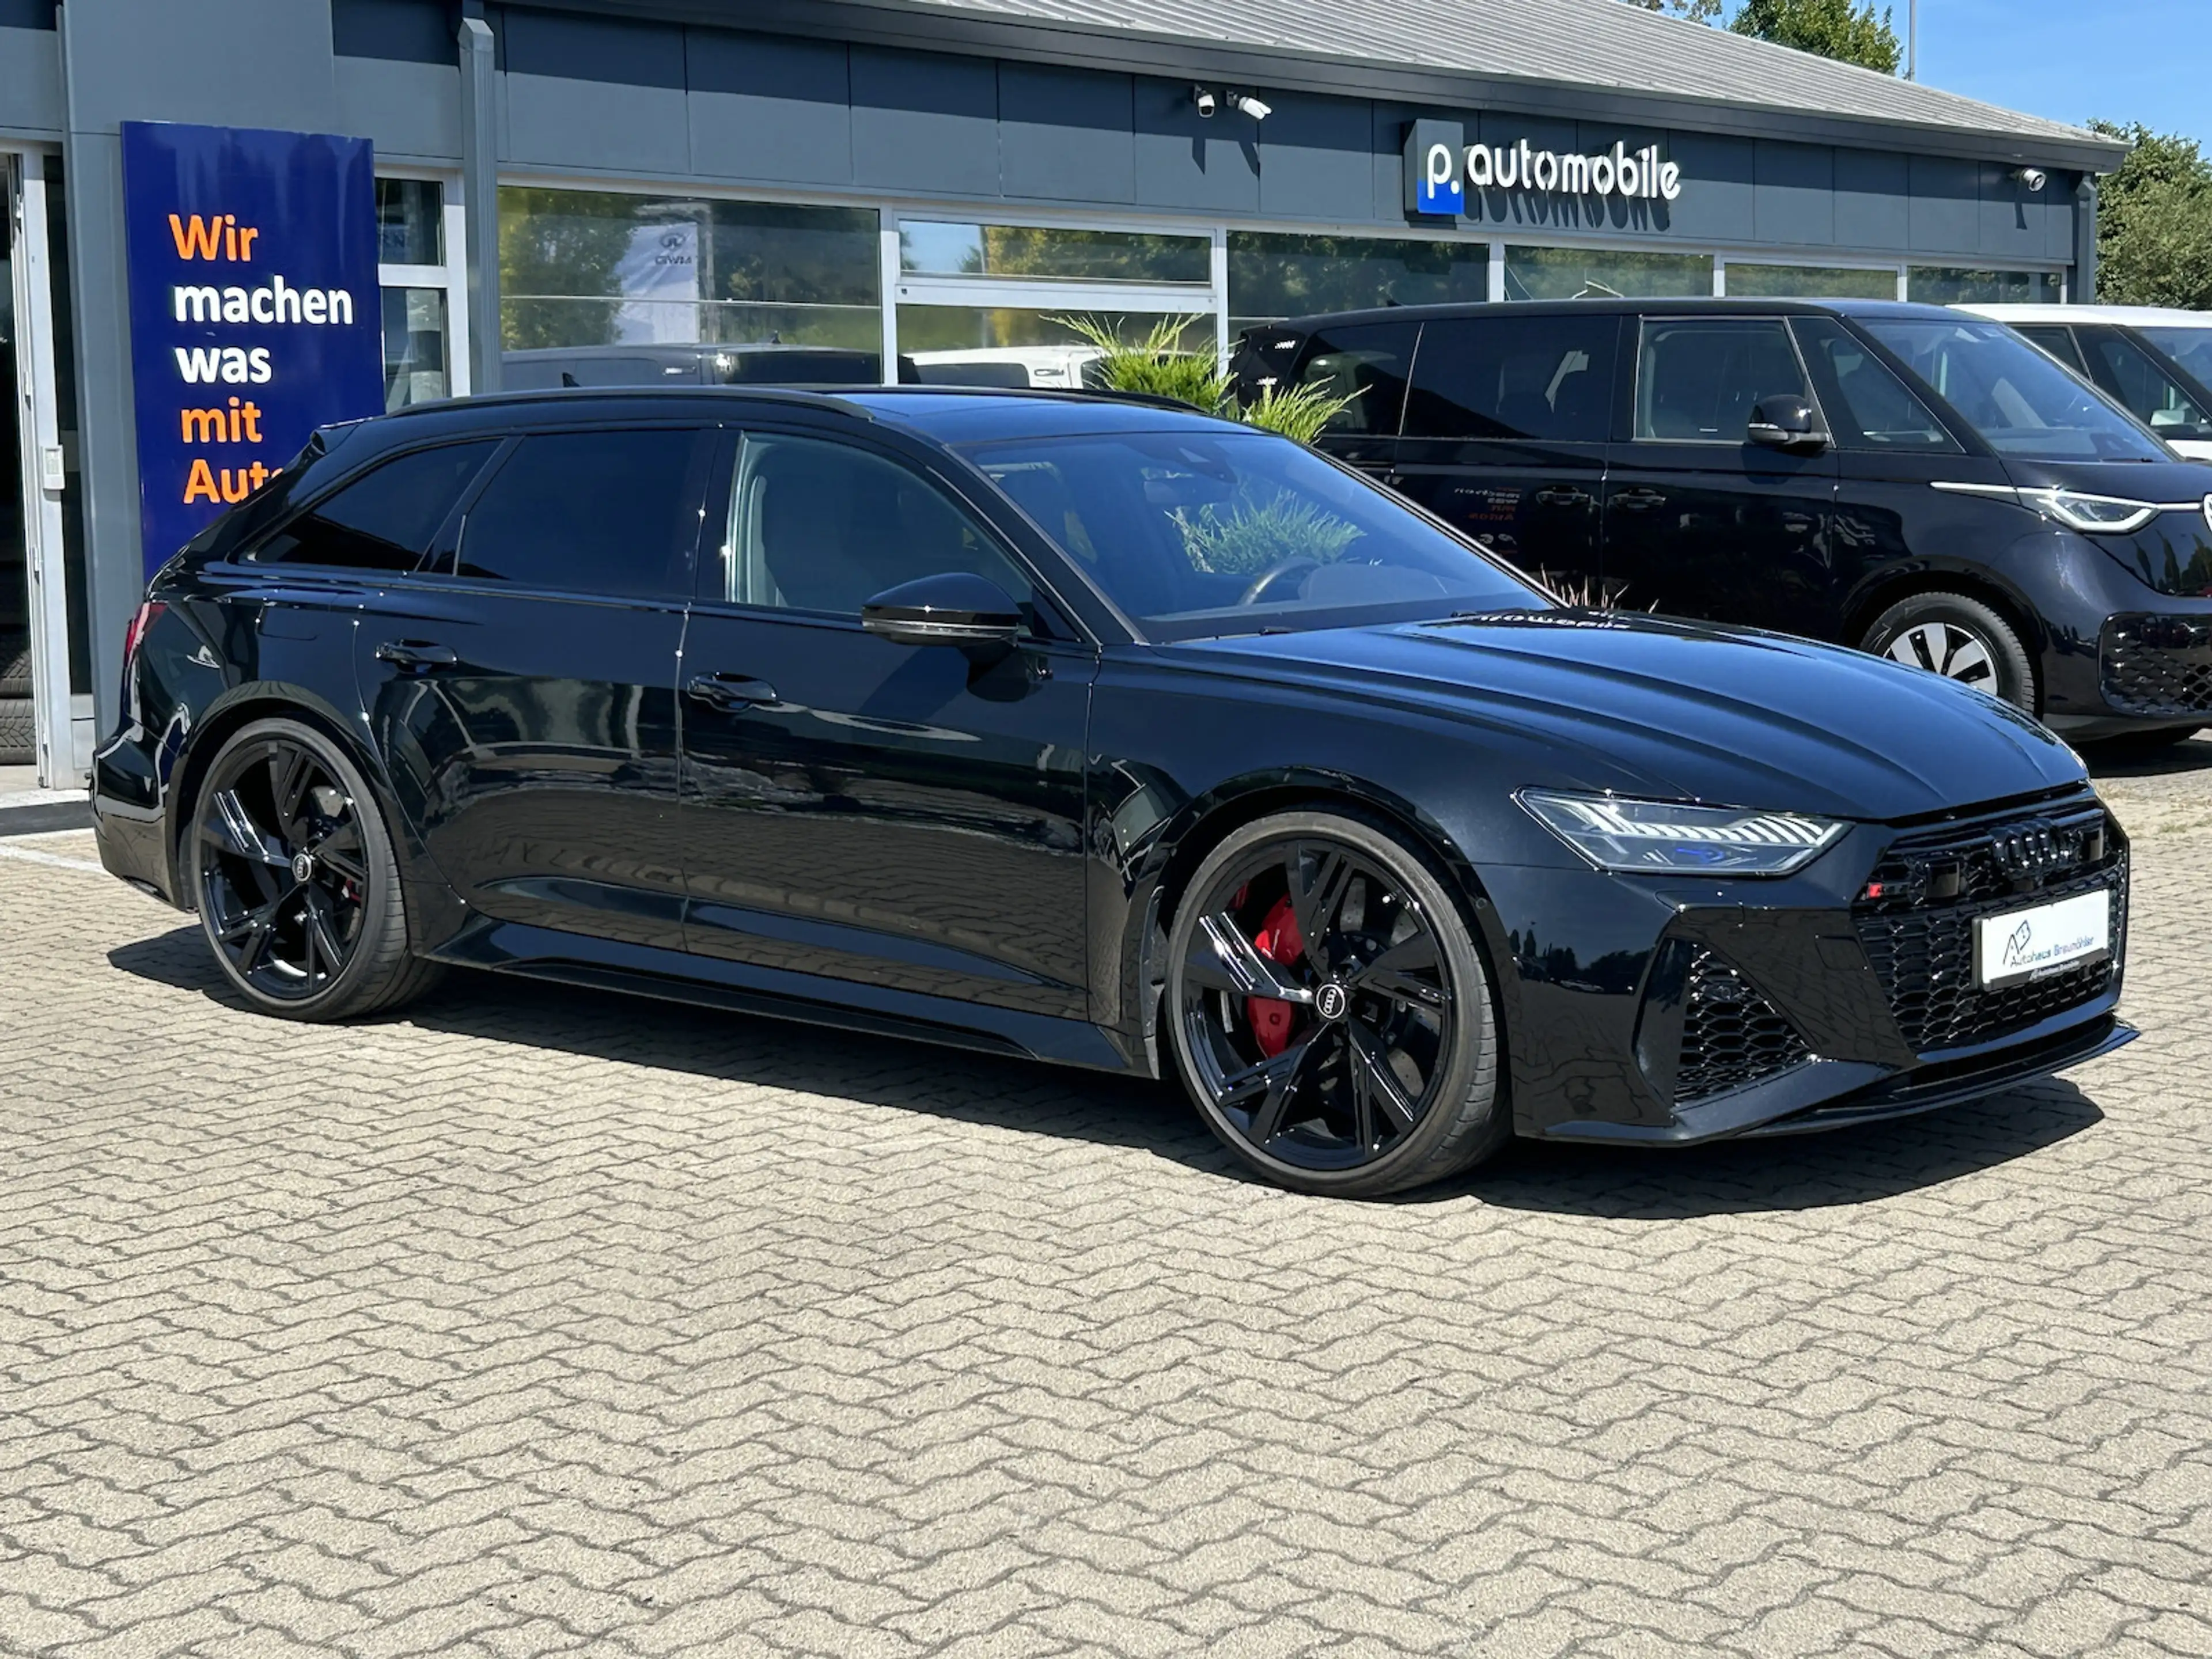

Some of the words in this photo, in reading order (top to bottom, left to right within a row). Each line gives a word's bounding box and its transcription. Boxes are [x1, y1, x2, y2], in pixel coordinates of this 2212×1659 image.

[1467, 138, 1681, 200] automobile
[168, 214, 259, 262] Wir
[174, 274, 354, 325] machen
[175, 346, 272, 384] was
[181, 396, 263, 444] mit
[183, 459, 284, 504] Aut
